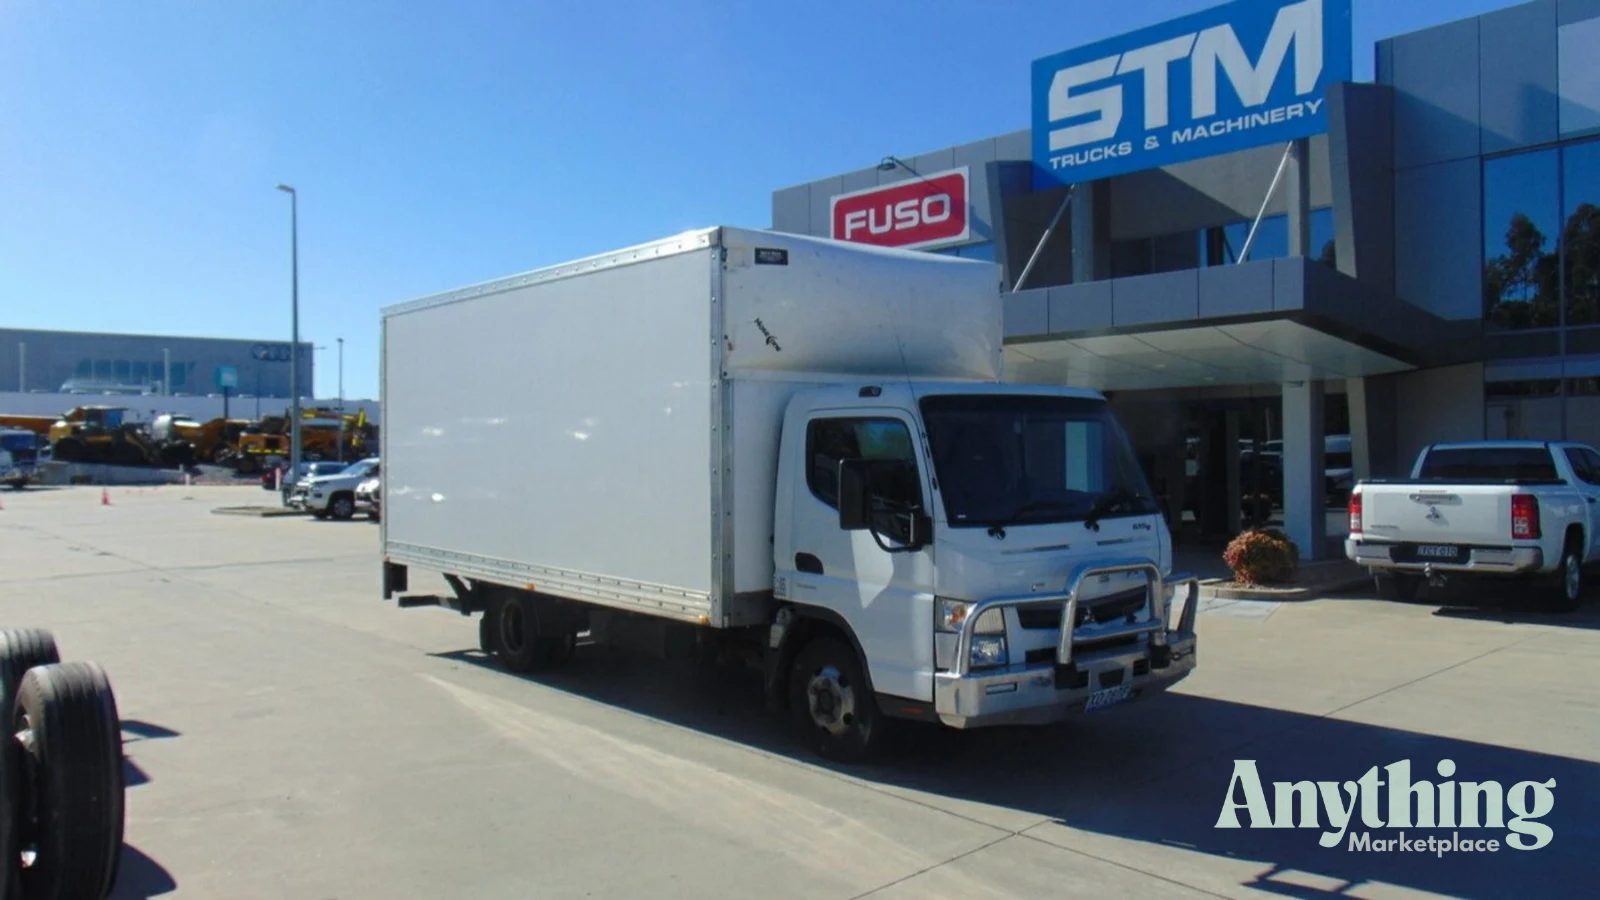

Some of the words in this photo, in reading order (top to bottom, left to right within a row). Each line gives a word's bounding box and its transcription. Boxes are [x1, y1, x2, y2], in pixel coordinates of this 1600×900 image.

[1048, 0, 1323, 151] STM
[1049, 141, 1132, 169] TRUCKS
[1144, 136, 1160, 150] &
[1171, 98, 1324, 144] MACHINERY
[845, 193, 950, 240] FUSO
